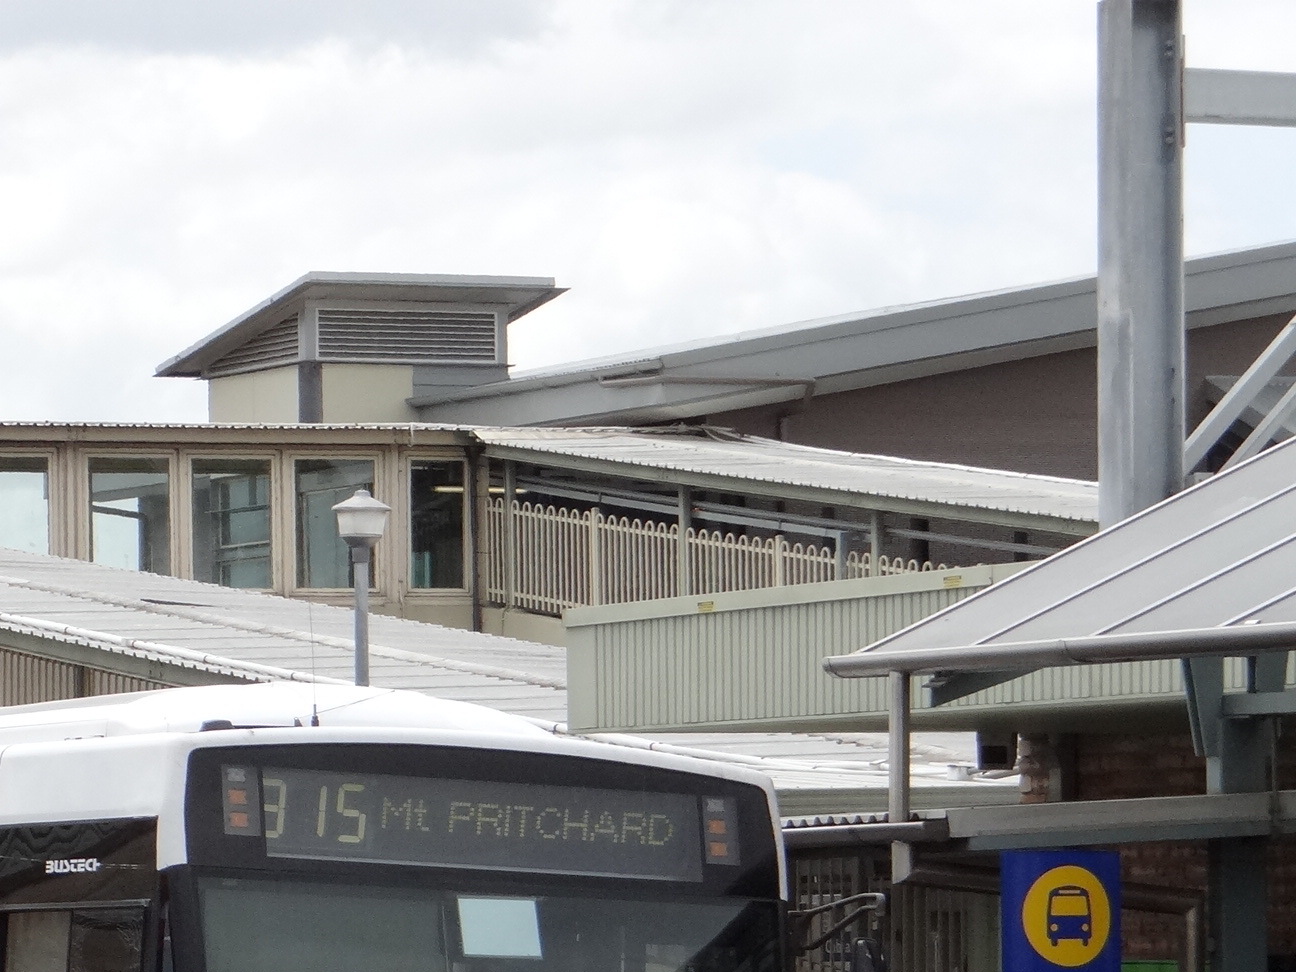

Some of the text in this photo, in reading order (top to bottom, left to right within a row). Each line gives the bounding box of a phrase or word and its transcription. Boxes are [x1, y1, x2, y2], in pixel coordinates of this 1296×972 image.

[380, 797, 430, 832] Mt
[447, 801, 674, 846] PRITCHARD
[45, 857, 101, 874] BUSTECH
